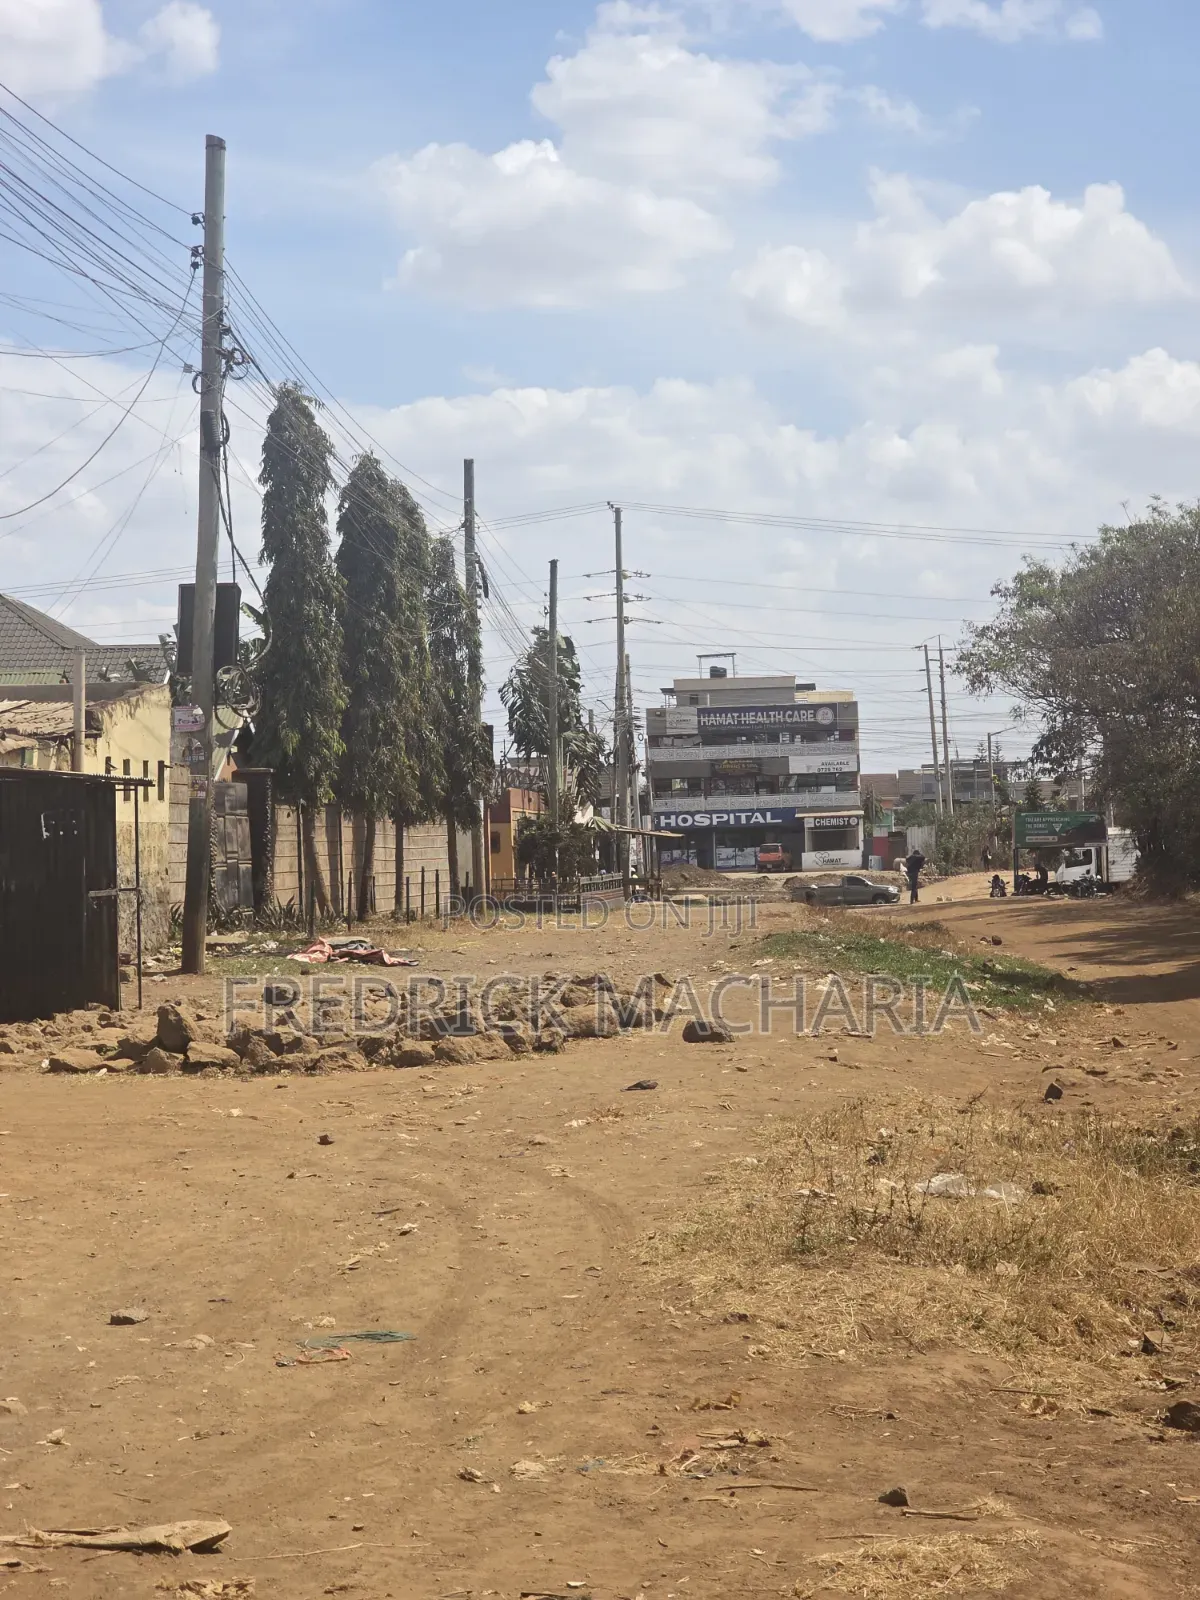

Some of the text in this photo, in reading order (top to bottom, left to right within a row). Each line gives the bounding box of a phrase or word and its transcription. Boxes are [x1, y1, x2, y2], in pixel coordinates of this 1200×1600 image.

[700, 709, 814, 726] HAMAT HEALTH CARE
[660, 812, 782, 827] HOSPITAL
[815, 817, 849, 826] CHEMIST
